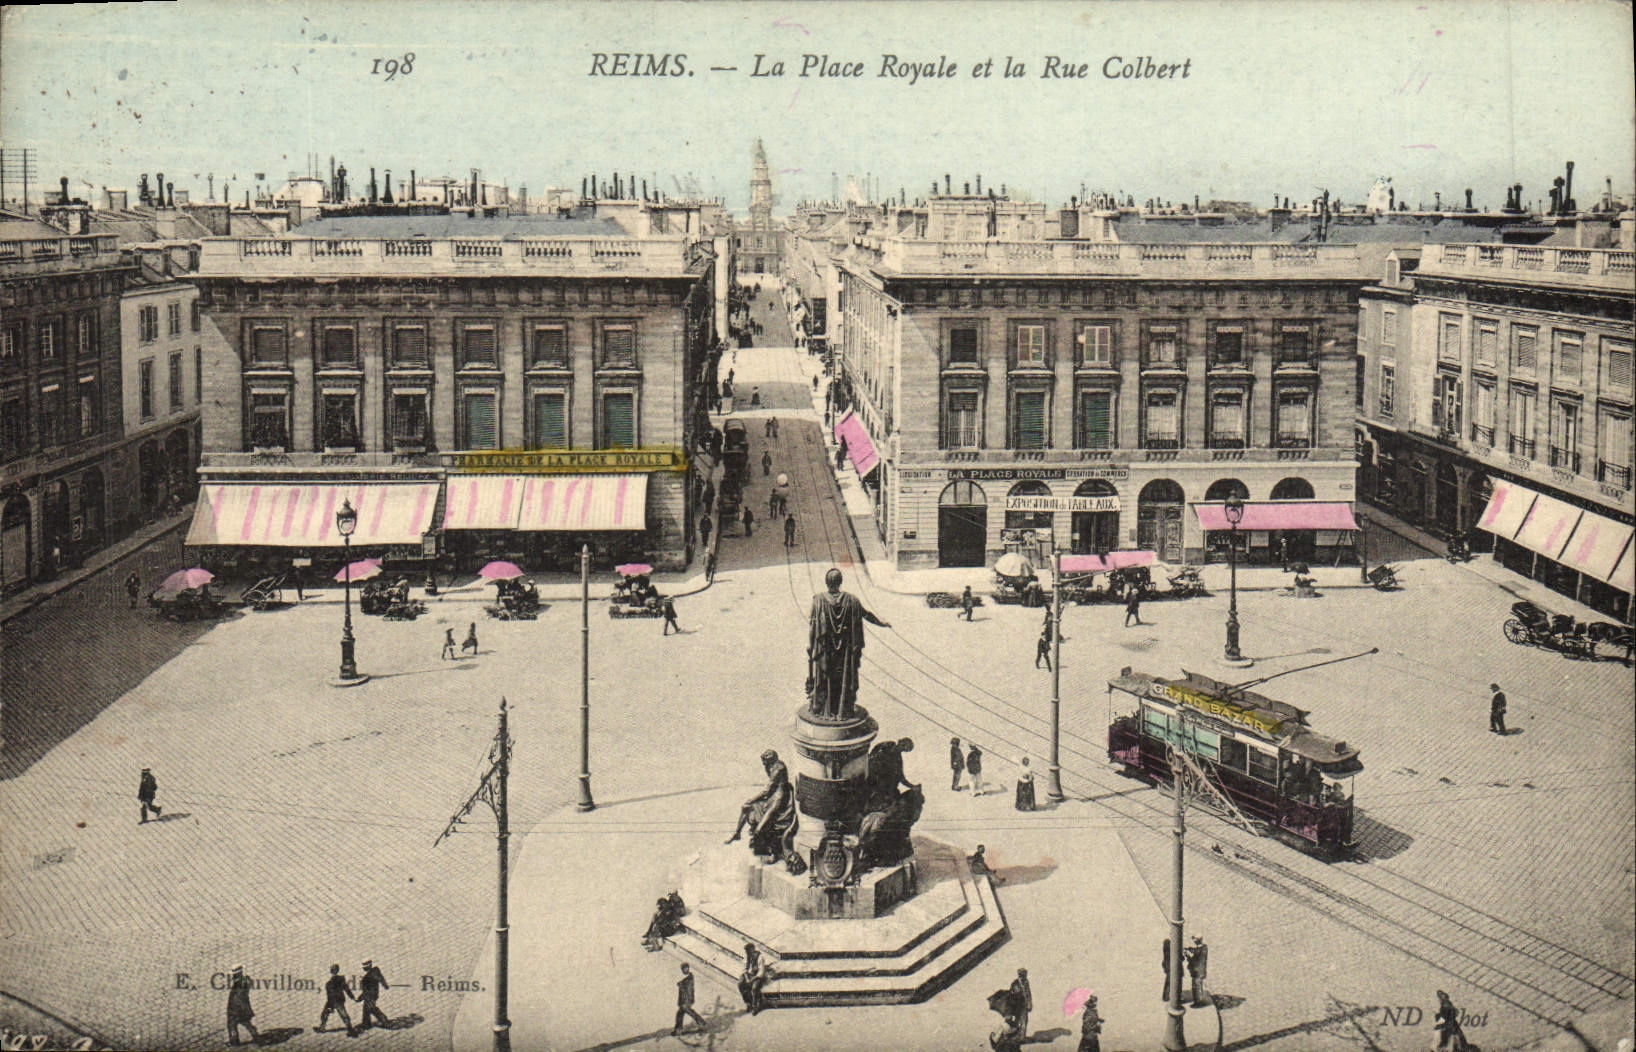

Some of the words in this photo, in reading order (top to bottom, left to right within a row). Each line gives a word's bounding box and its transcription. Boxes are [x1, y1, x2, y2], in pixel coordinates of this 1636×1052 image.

[548, 455, 564, 466] LA
[615, 453, 663, 465] ROYALE
[949, 470, 965, 479] LA
[971, 470, 1013, 479] PLACE
[1017, 470, 1062, 479] ROYALE
[1006, 497, 1059, 510] EXPOSITION
[1152, 682, 1204, 708] GRAND
[1209, 703, 1266, 732] BAZAR
